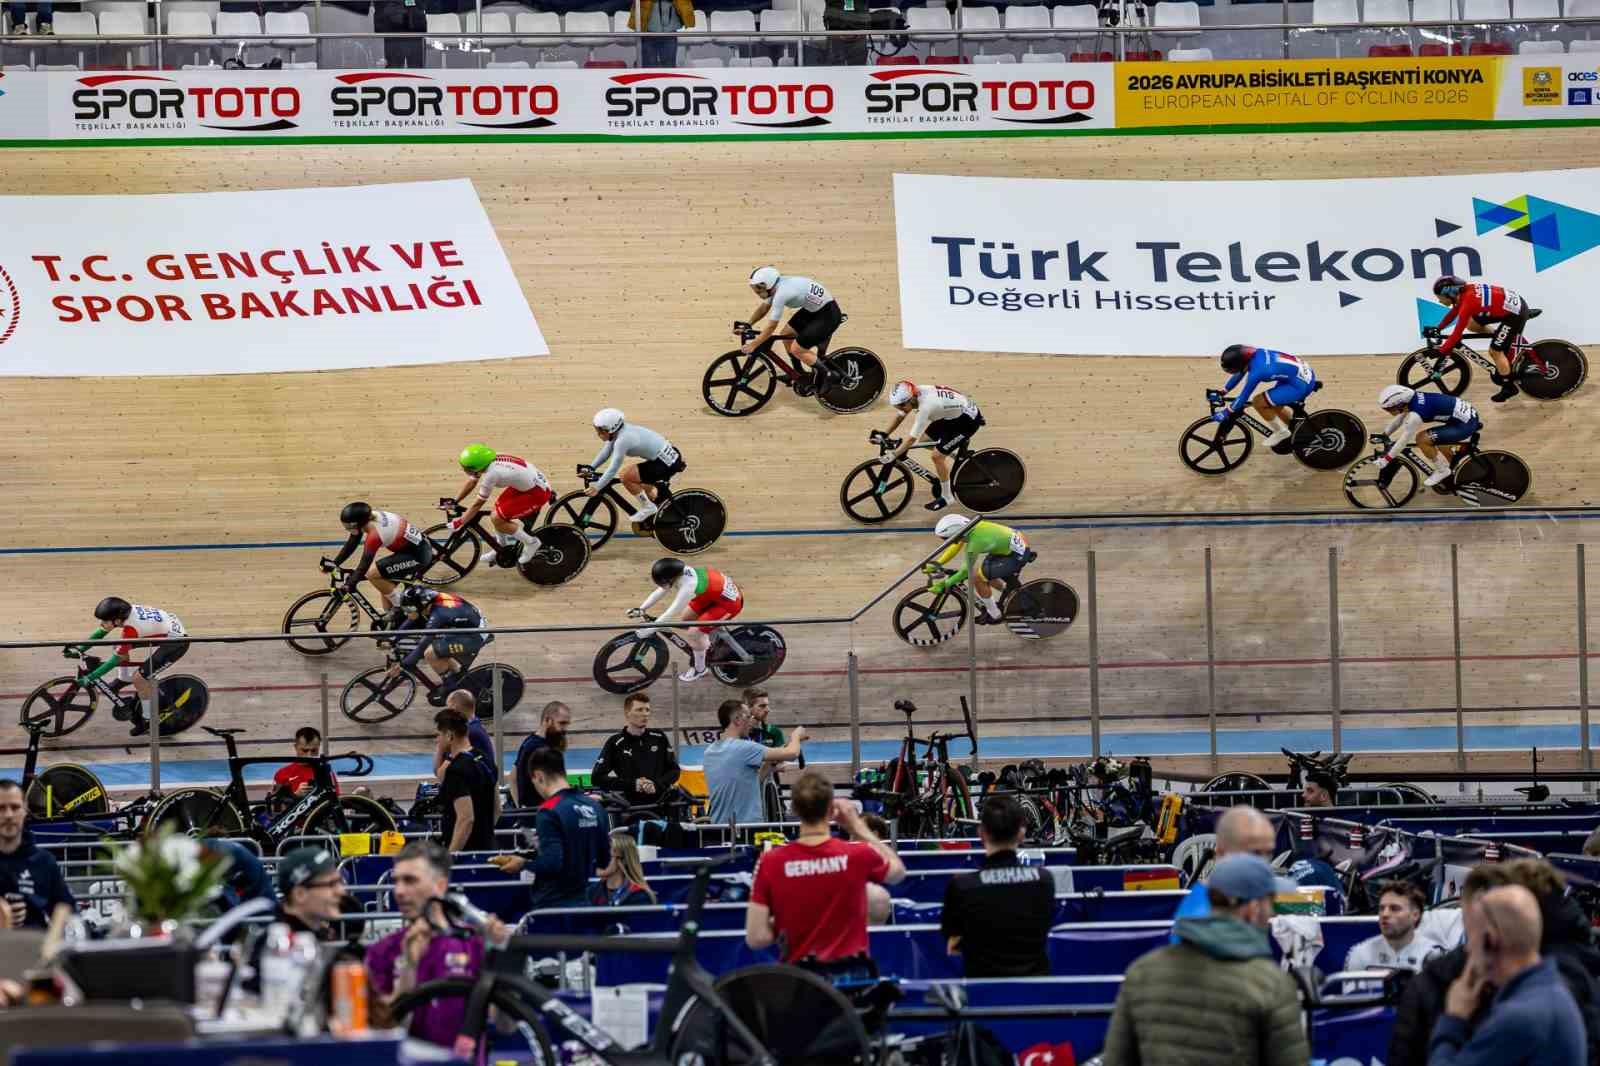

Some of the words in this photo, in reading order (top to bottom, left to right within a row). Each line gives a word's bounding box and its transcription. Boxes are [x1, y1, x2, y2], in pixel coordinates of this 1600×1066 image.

[1128, 75, 1173, 90] 2026
[1176, 73, 1247, 89] AVRUPA
[1249, 69, 1330, 87] BİSİKLETİ
[1334, 66, 1420, 90] BAŞKENTİ
[1424, 69, 1483, 84] KONYA
[1144, 94, 1236, 111] EUROPEAN
[1242, 92, 1312, 108] CAPITAL
[1317, 91, 1338, 106] OF
[1345, 90, 1418, 105] CYCLING
[1424, 89, 1469, 104] 2026
[31, 254, 133, 282] T.C.
[146, 241, 382, 284] GENÇLİK
[390, 240, 464, 269] VE
[931, 236, 1110, 282] Türk
[1136, 240, 1483, 283] Telekom
[52, 295, 193, 323] SPOR
[200, 275, 482, 320] BAKANLIĞI
[809, 283, 825, 298] 109
[949, 285, 1080, 312] Değerli
[1095, 290, 1276, 311] Hissettirir
[1494, 323, 1512, 346] NOR
[275, 795, 318, 834] KOGA
[784, 854, 848, 878] GERMANY
[980, 866, 1040, 884] GERMANY
